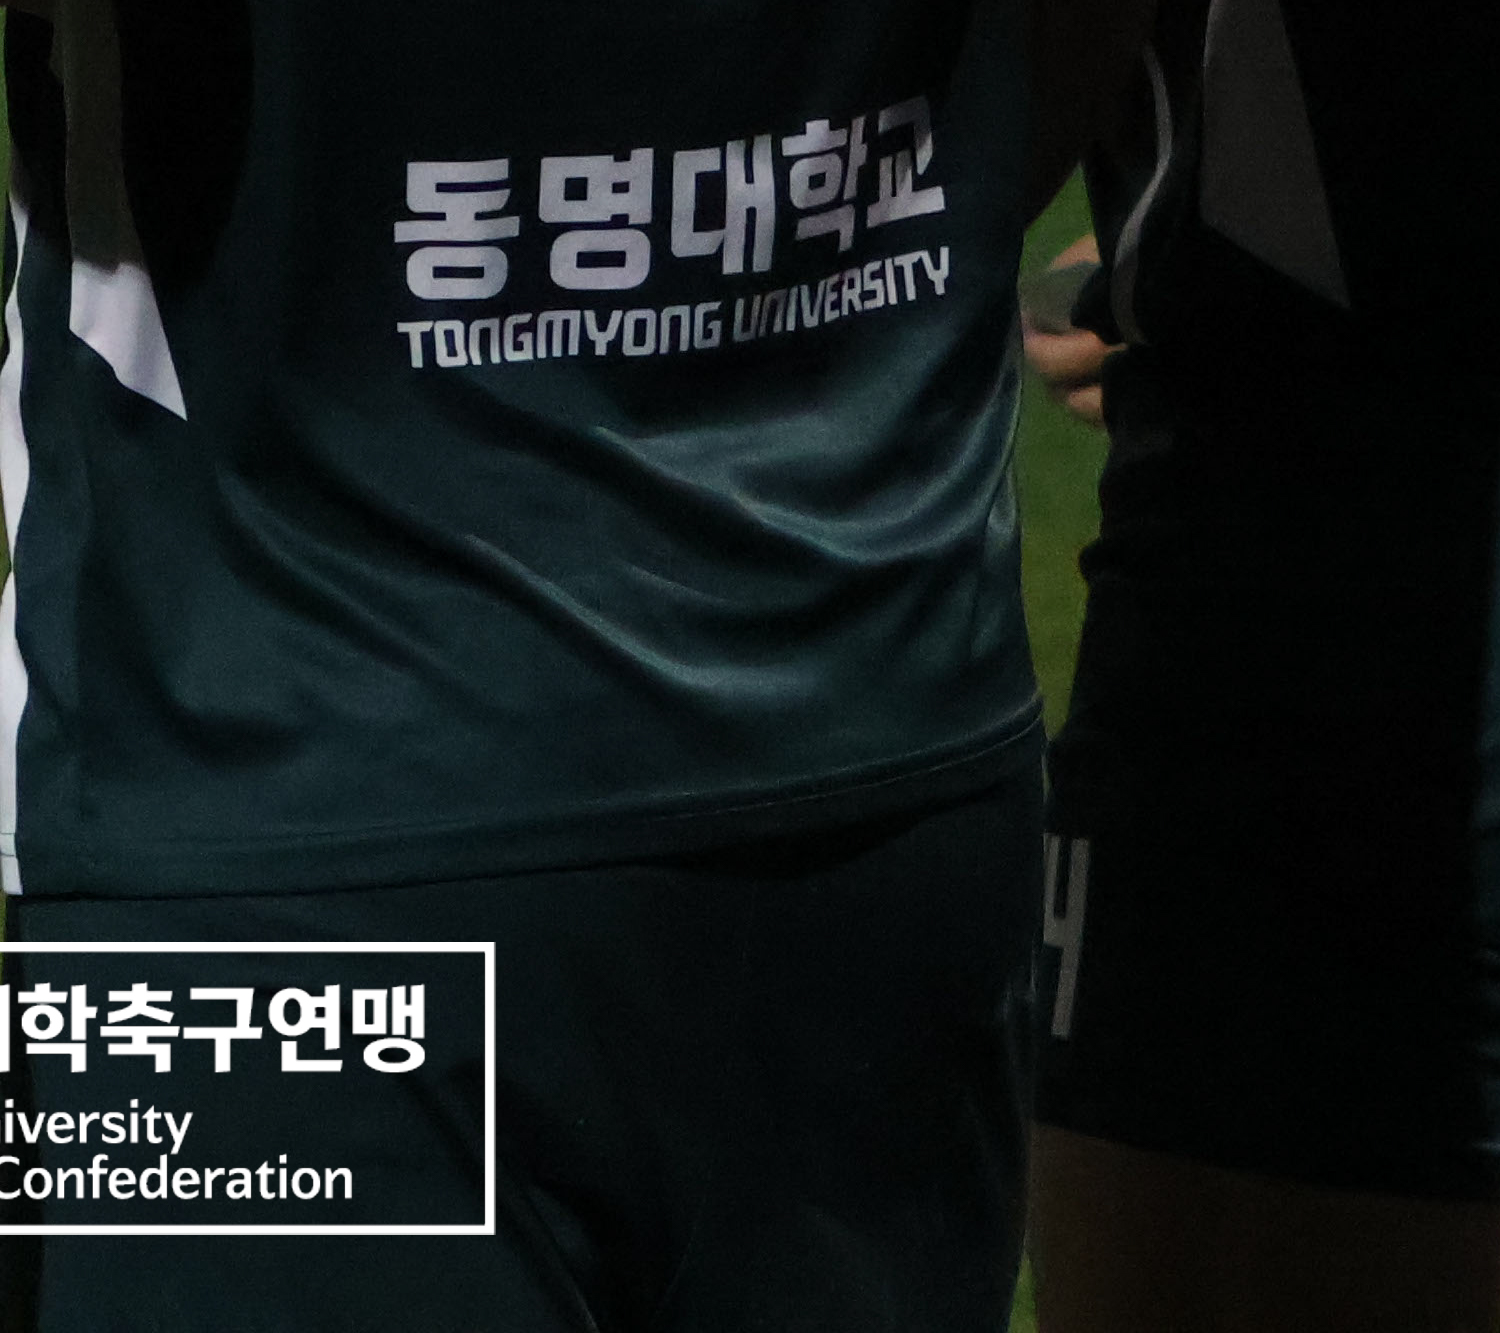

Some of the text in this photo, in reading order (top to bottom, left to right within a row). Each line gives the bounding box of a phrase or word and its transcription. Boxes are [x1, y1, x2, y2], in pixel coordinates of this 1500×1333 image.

[394, 95, 946, 301] 동명대학교
[396, 245, 950, 369] TONGMYONG UNIVERSITY
